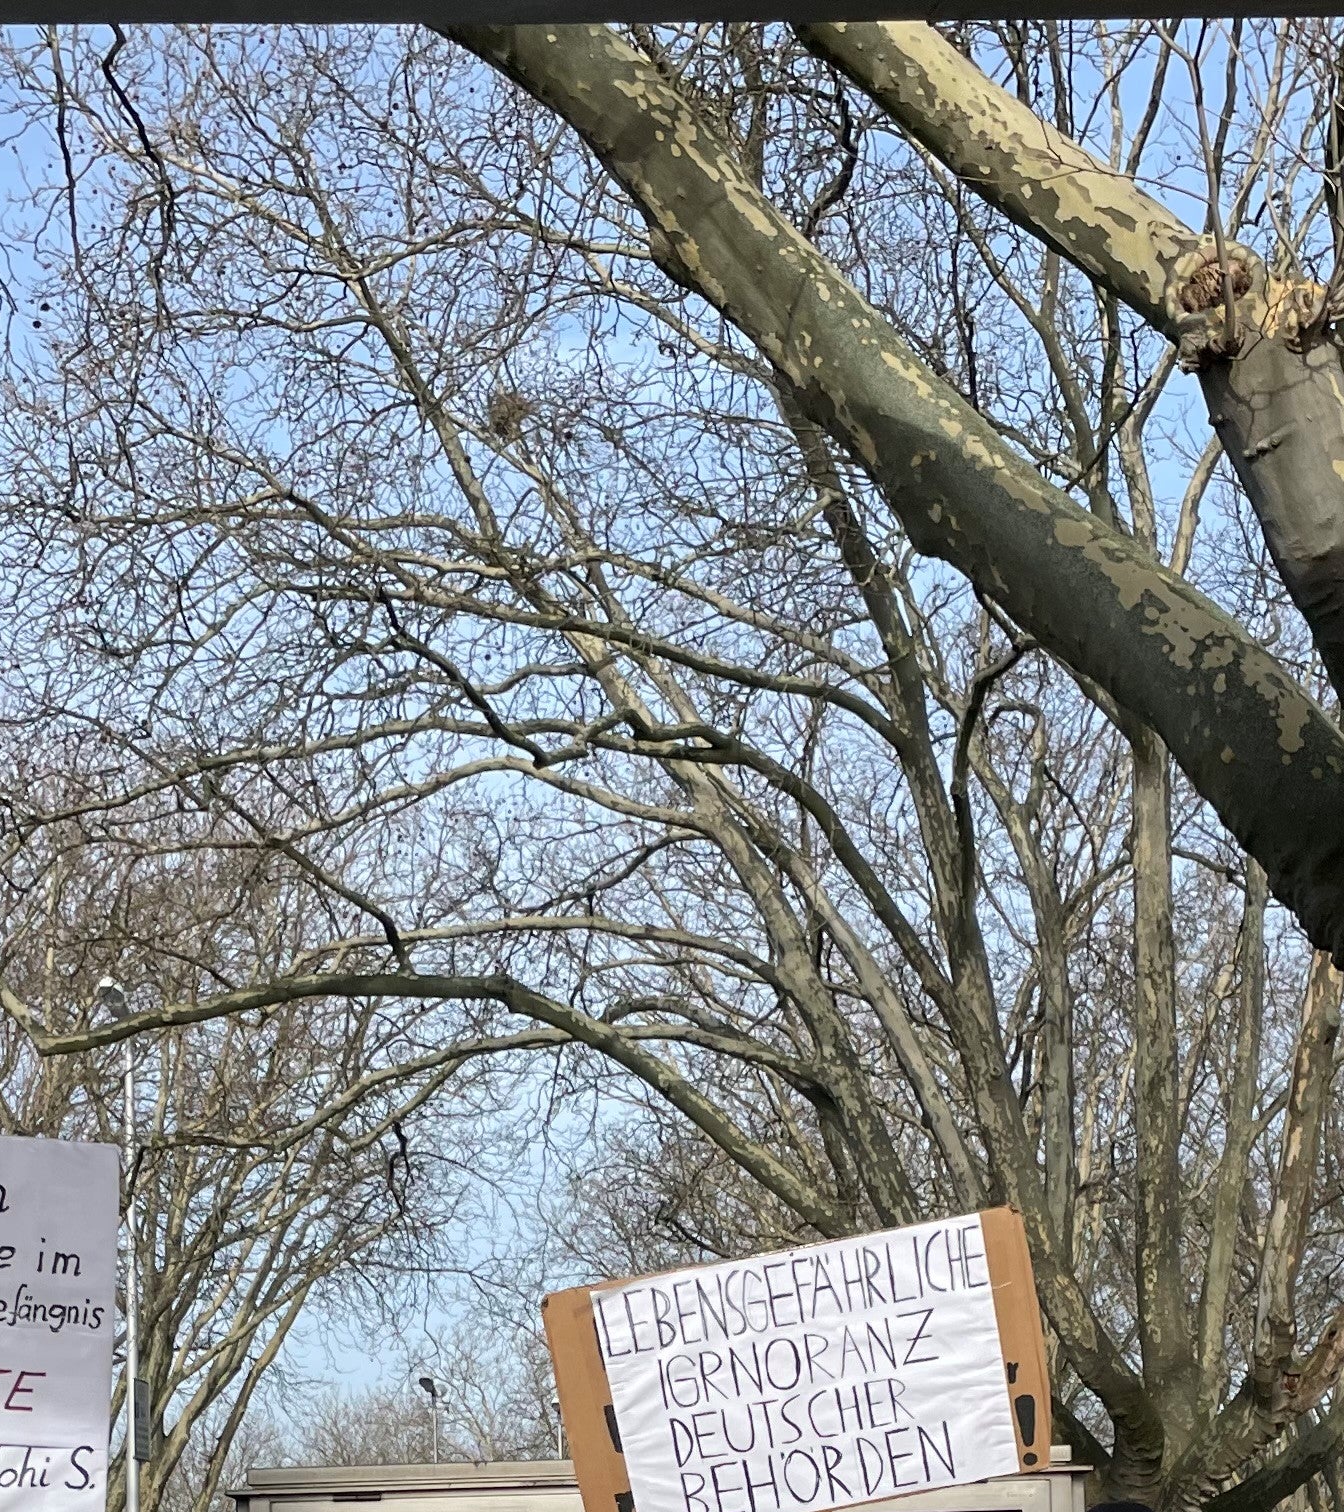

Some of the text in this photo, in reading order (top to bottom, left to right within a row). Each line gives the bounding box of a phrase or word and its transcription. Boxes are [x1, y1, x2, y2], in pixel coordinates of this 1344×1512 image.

[36, 1237, 82, 1276] im
[597, 1225, 989, 1358] LEBENSGEFÄHRLICHE
[658, 1307, 940, 1410] IGRNORANZ
[64, 1445, 97, 1490] S.
[669, 1378, 915, 1468] DEUTSCHER
